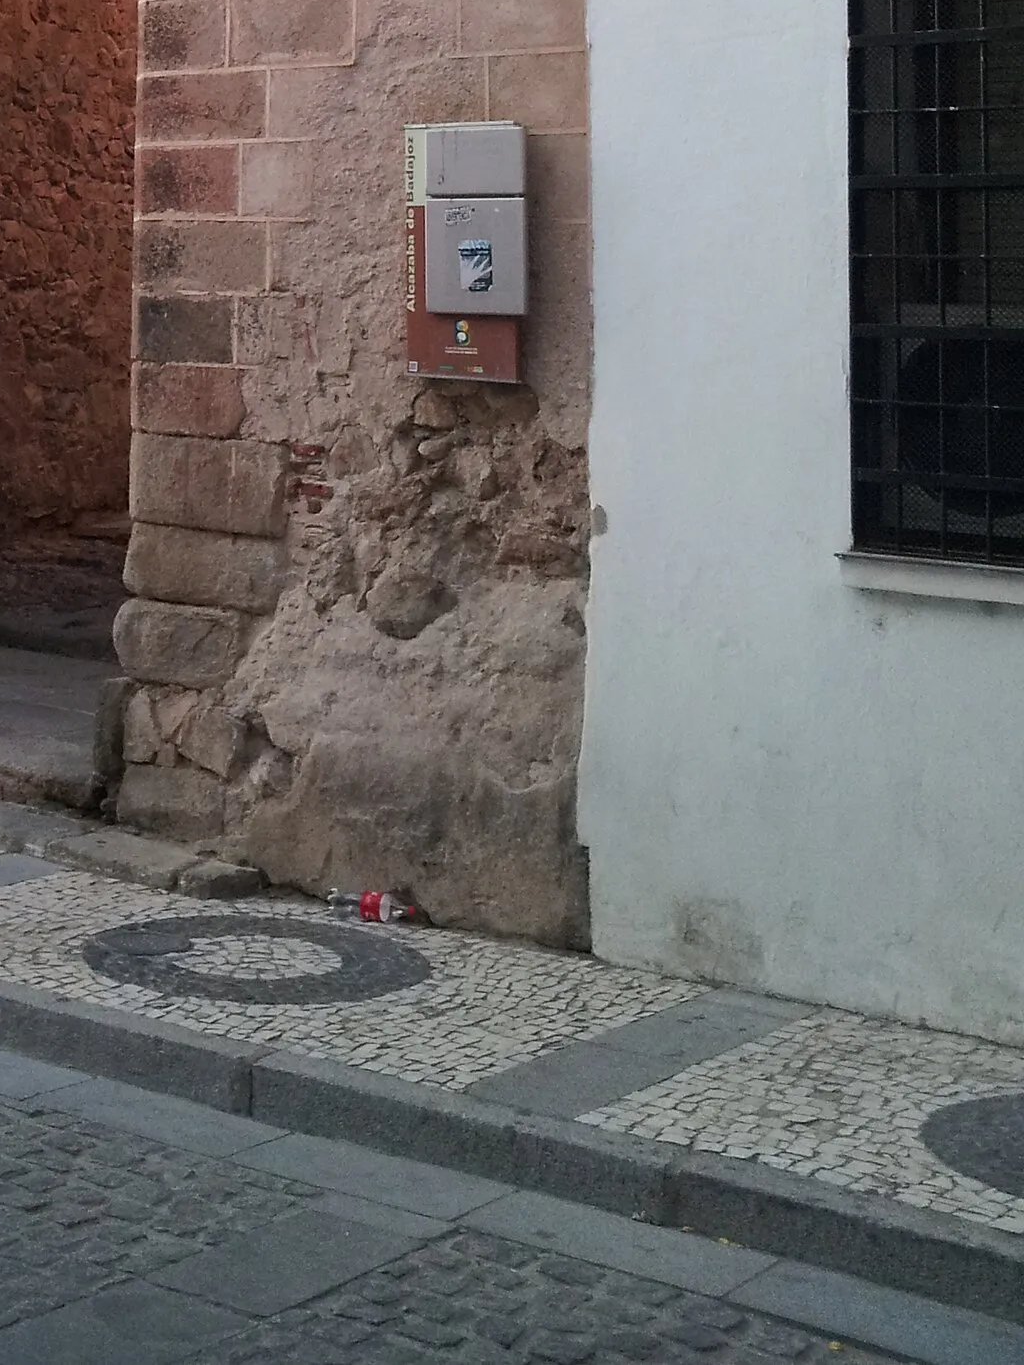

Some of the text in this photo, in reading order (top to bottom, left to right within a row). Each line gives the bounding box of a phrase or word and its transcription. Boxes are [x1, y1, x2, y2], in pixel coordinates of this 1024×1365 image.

[406, 137, 416, 313] Alcazaba de Badajoz
